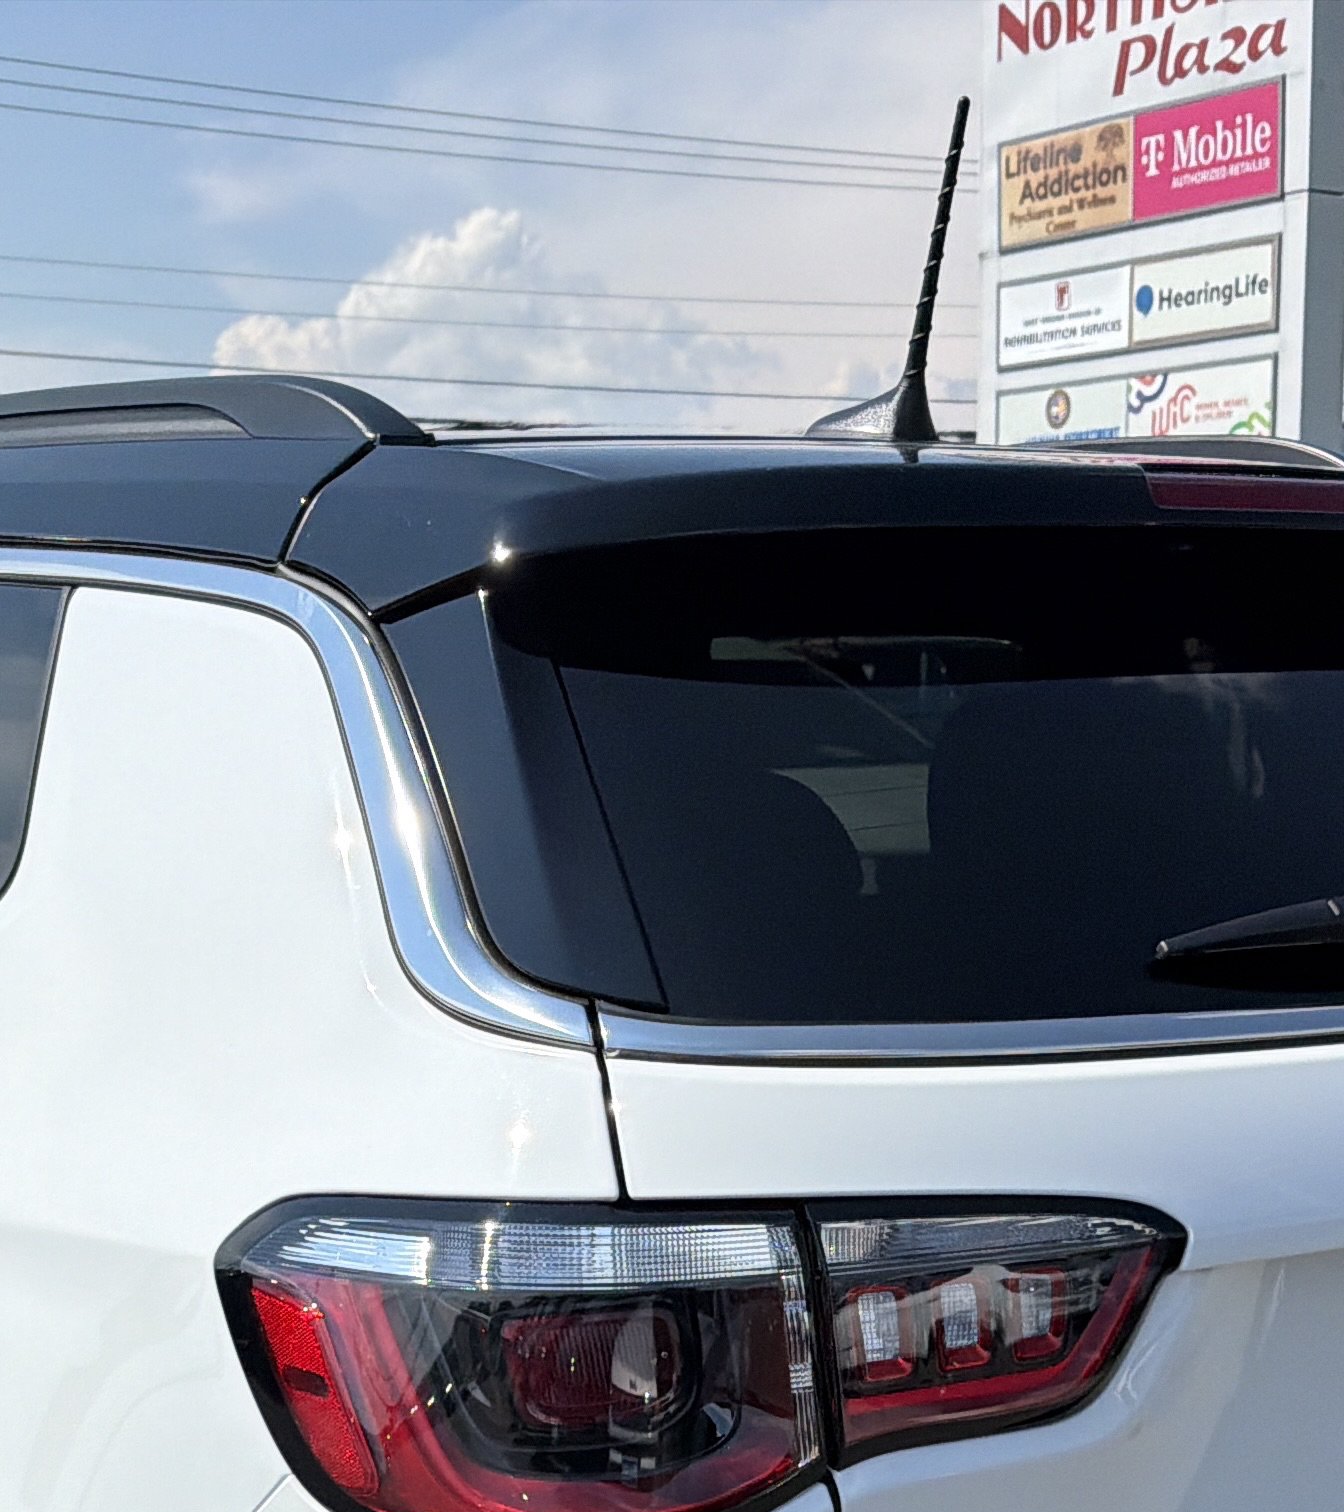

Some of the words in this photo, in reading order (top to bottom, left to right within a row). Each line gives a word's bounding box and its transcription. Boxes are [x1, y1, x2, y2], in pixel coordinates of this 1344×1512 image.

[1112, 18, 1288, 97] Plaza
[1004, 141, 1083, 179] Lifeline
[1172, 112, 1272, 172] Mobile
[1018, 160, 1127, 205] Addiction
[1158, 273, 1269, 312] HearingLife
